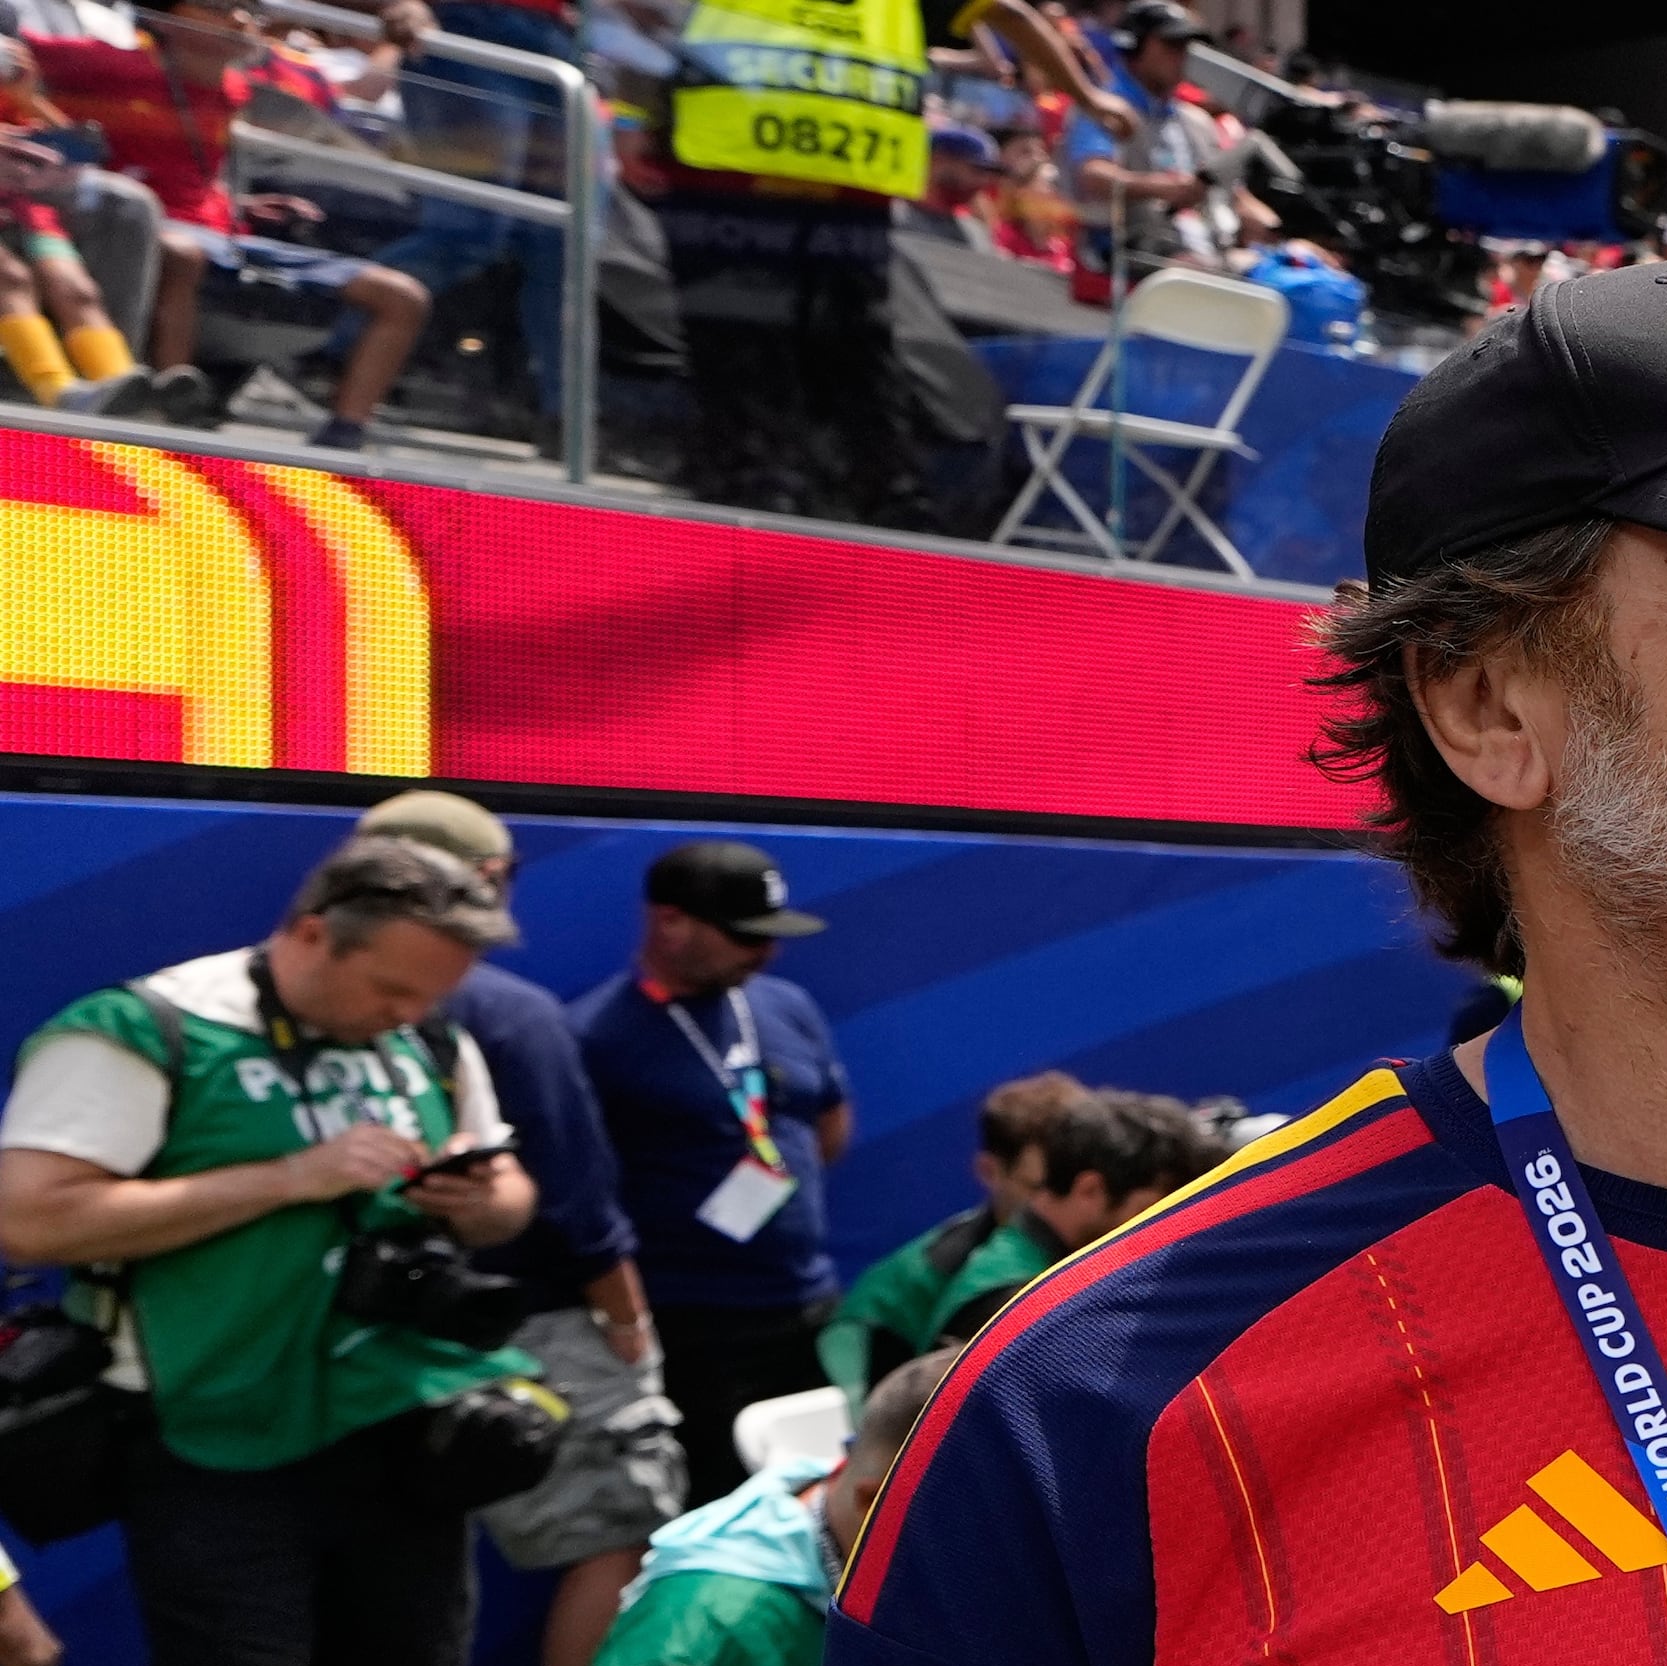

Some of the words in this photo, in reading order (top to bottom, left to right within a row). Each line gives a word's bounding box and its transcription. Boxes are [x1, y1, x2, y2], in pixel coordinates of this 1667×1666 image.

[751, 111, 903, 175] 08271
[1524, 1154, 1603, 1278] 2026
[1577, 1283, 1636, 1359] CUP
